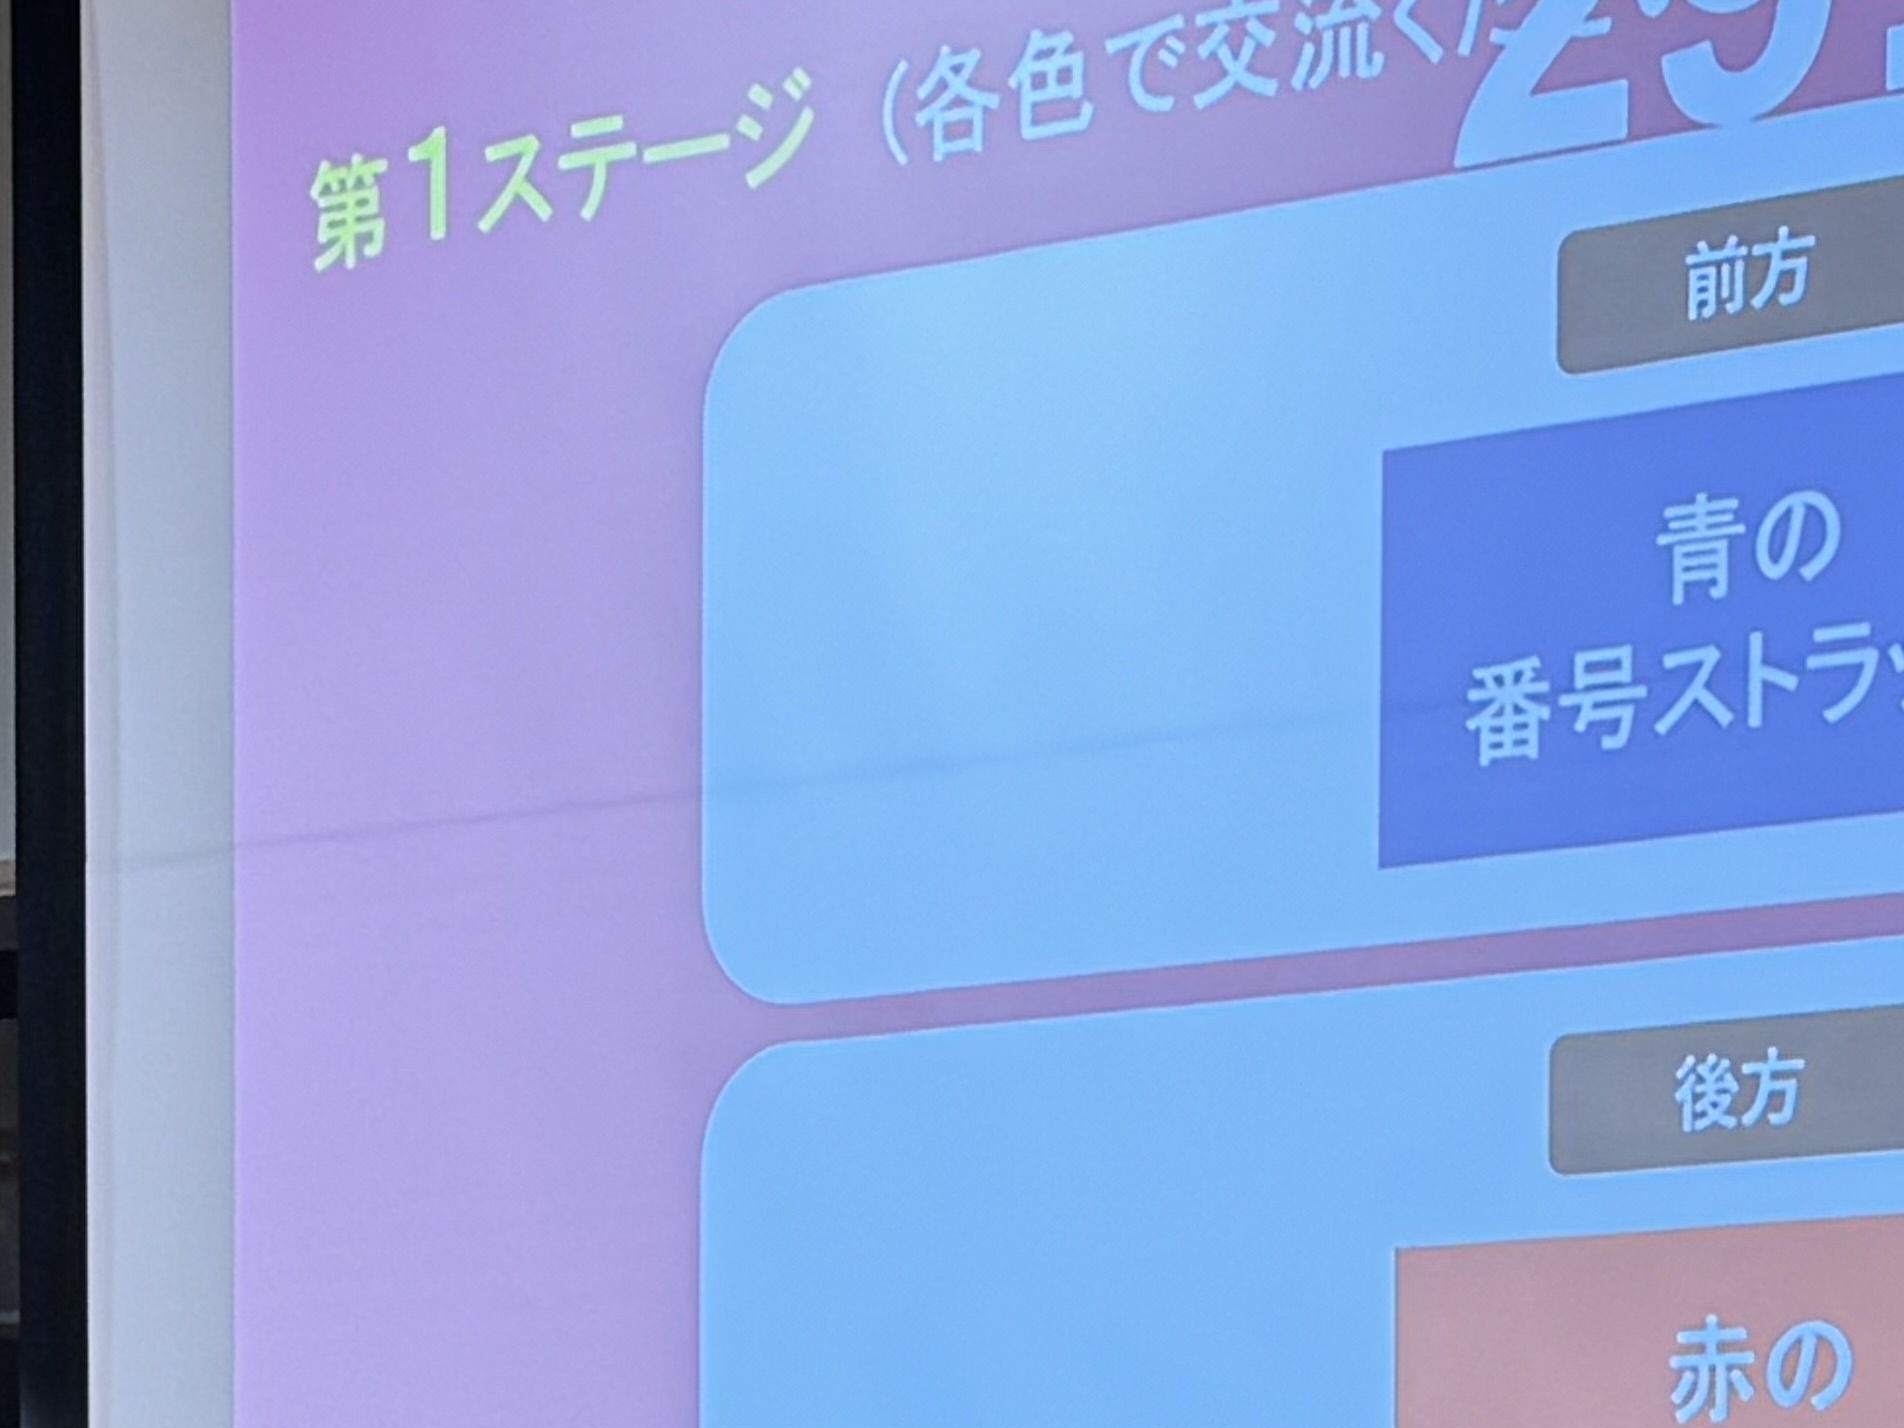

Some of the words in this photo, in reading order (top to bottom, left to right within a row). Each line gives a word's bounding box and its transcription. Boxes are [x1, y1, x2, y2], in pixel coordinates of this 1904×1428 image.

[308, 66, 814, 272] 第1ステージ
[1684, 225, 1816, 320] 前方
[1656, 489, 1841, 605] 青の
[1673, 1046, 1806, 1132] 後方
[1668, 1313, 1853, 1424] 赤の
